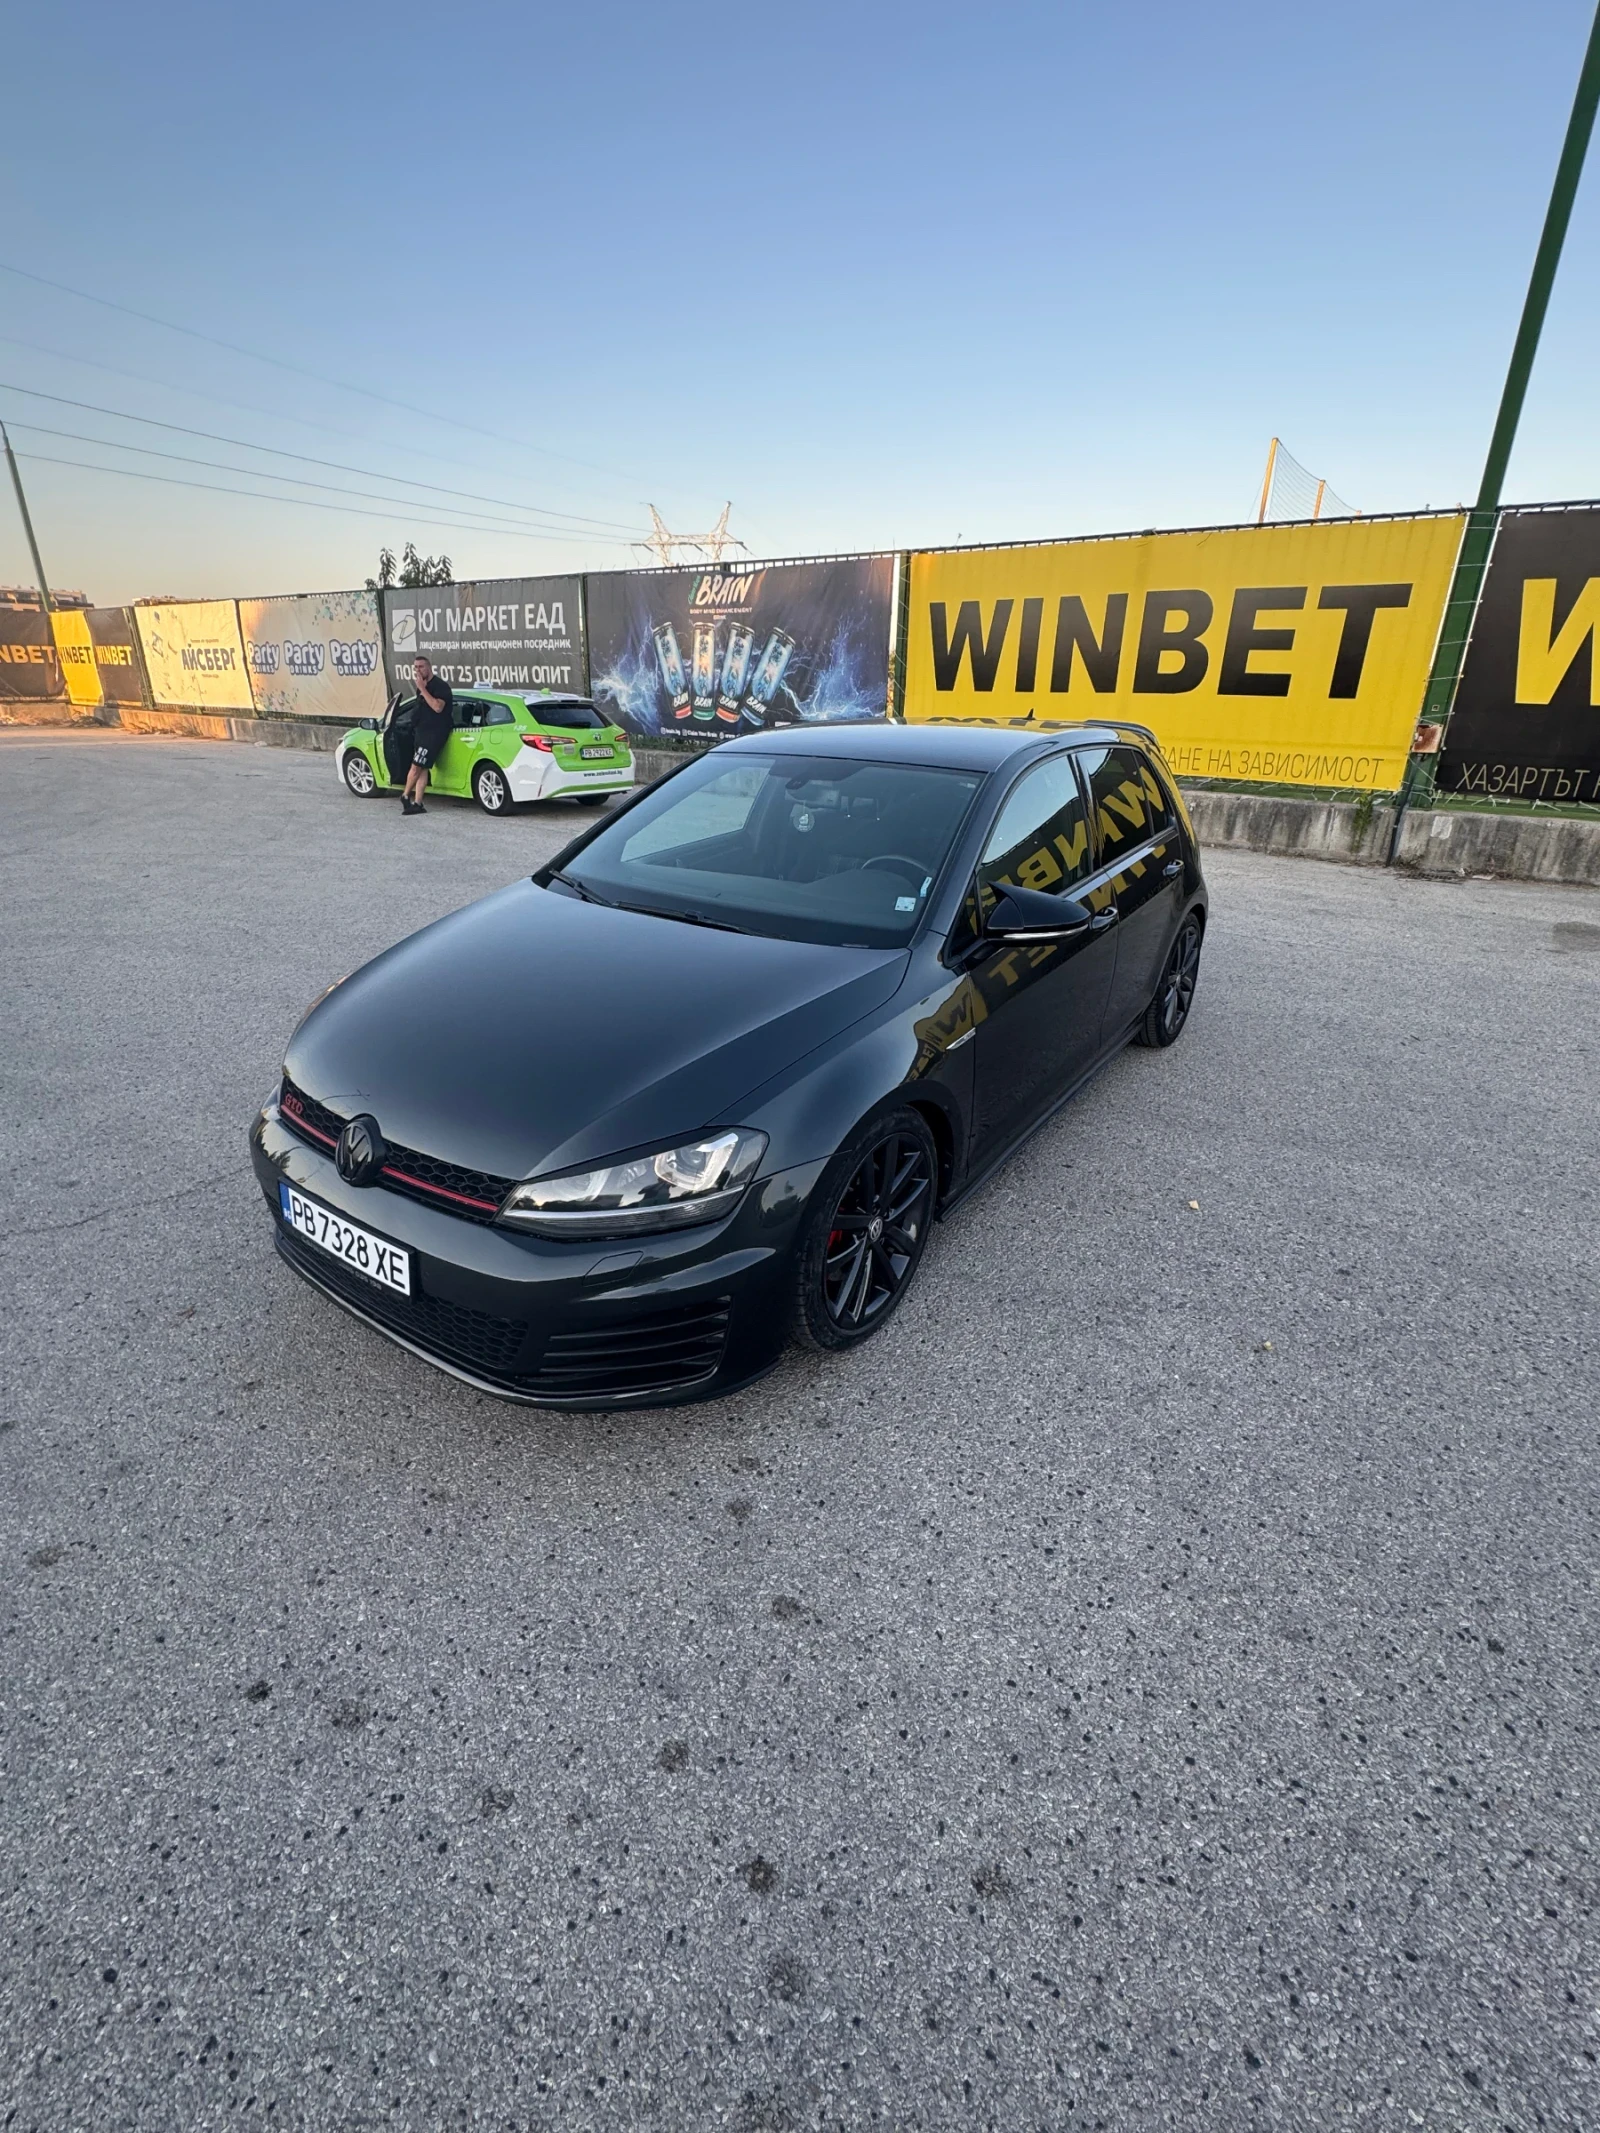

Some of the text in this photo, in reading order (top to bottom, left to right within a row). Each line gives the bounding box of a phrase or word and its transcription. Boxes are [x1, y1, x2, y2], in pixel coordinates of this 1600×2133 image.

[695, 574, 754, 606] BRAIN
[418, 602, 566, 635] ЮГ МАРКЕТ ЕАД
[247, 640, 279, 670] Party
[419, 639, 571, 651] лицензиран инвестиционен посредник
[929, 583, 1414, 699] WINBET
[95, 645, 132, 666] WINBET
[181, 643, 236, 671] АЙСБЕРГ
[284, 640, 324, 671] Party
[330, 640, 377, 671] Party
[290, 665, 318, 676] DRINKS
[338, 665, 369, 676] DRINKS
[395, 664, 571, 686] ПОВЕ ОТ 25 ГОДИНИ ОПИТ
[694, 696, 713, 708] BRAIN
[720, 695, 739, 710] BRAIN
[746, 696, 767, 714] BRAIN
[1208, 748, 1232, 773] НА
[1238, 750, 1384, 783] ЗАВИСИМОСТ
[1456, 762, 1590, 798] ХАЗАРТЪТ
[285, 1093, 303, 1114] GTD
[318, 1211, 369, 1268] 7328
[374, 1242, 406, 1289] XE
